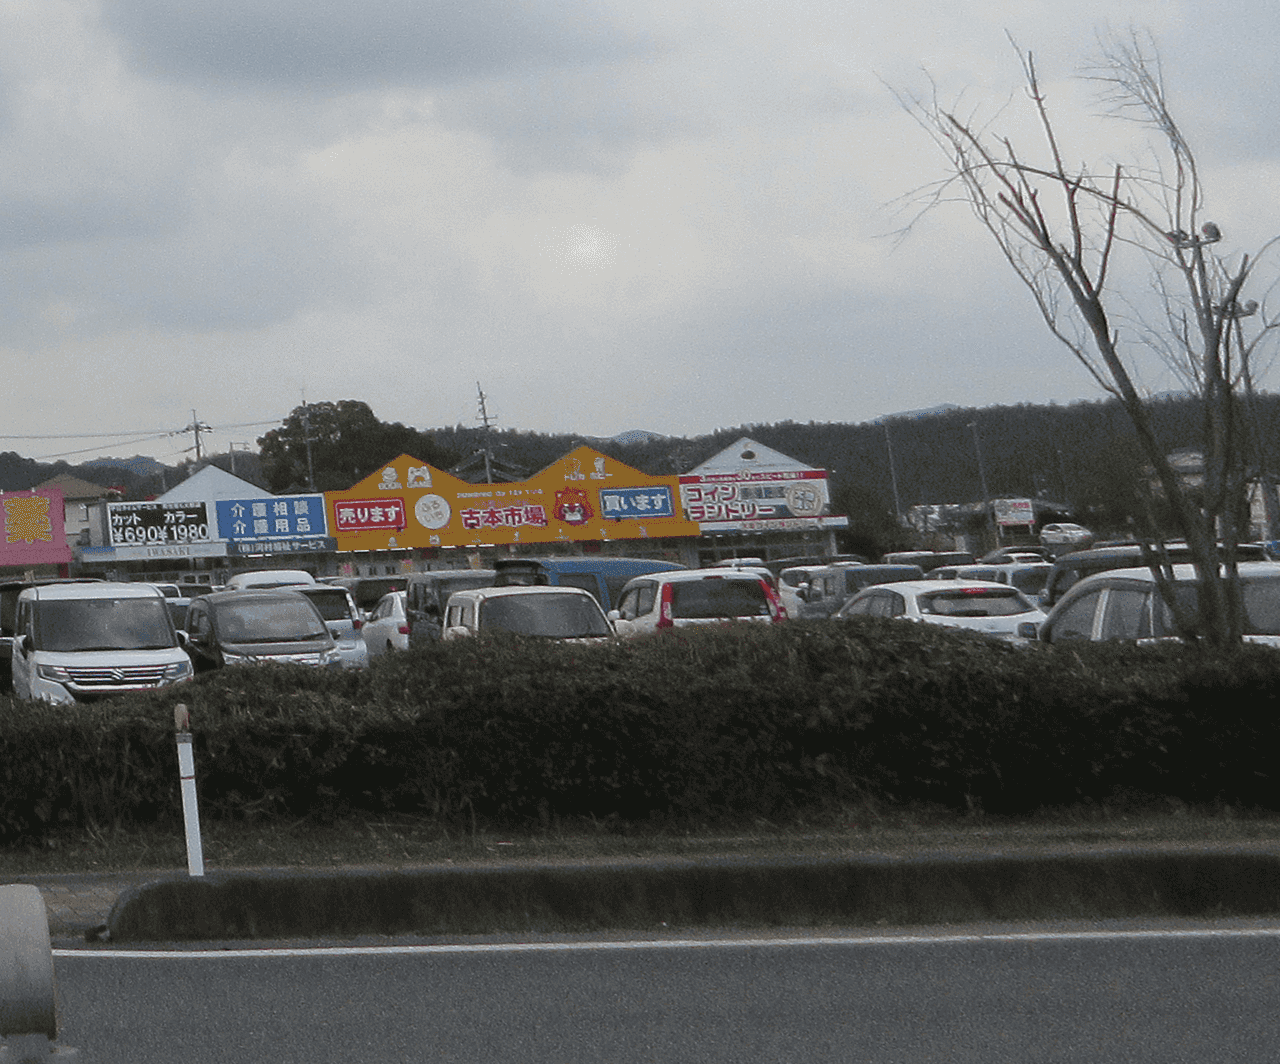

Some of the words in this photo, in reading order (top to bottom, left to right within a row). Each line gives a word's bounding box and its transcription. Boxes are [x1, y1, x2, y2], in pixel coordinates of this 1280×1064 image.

[604, 493, 667, 512] 買います
[686, 485, 737, 503] コイン
[230, 500, 309, 517] 介護相談
[339, 505, 400, 524] 売ります
[460, 505, 545, 529] 古本市場
[689, 502, 776, 520] ランドリー
[3, 495, 53, 544] 薬
[112, 512, 142, 526] カット
[164, 510, 198, 524] カラー
[232, 518, 310, 534] 介護用品
[113, 526, 157, 543] ¥690
[146, 546, 190, 556] IWASAKI
